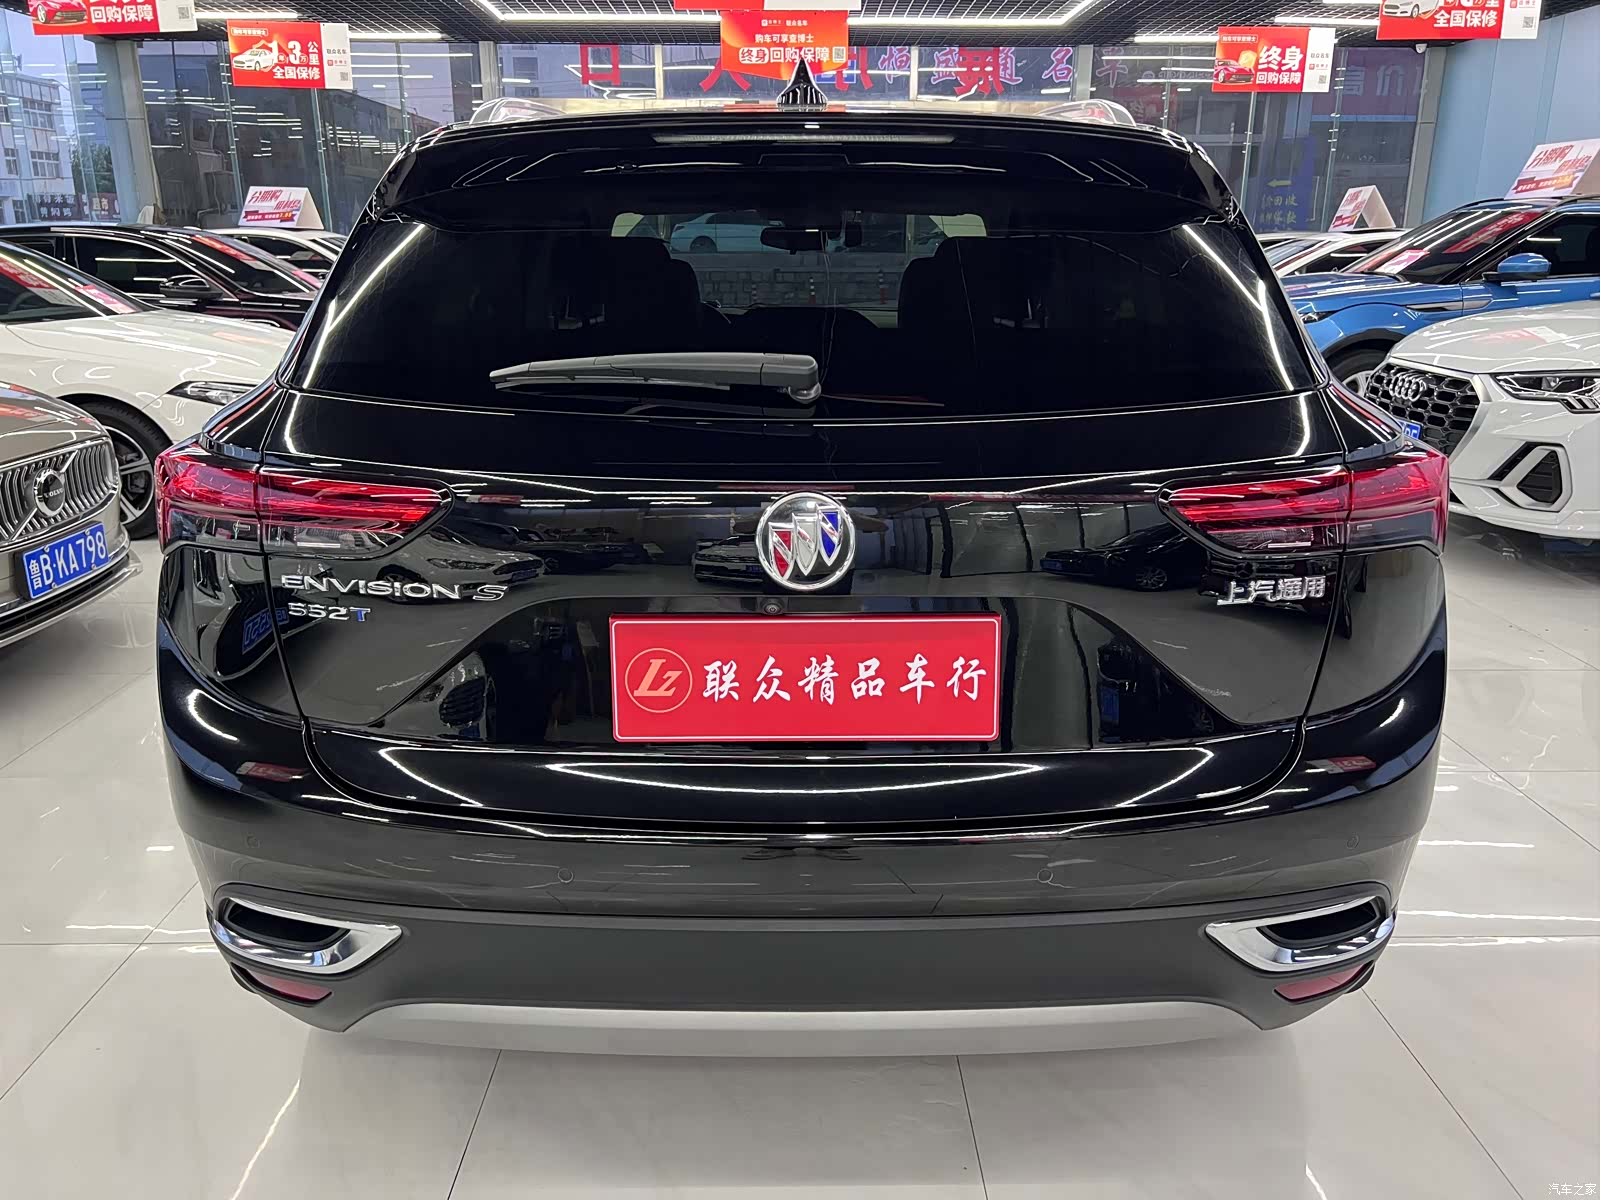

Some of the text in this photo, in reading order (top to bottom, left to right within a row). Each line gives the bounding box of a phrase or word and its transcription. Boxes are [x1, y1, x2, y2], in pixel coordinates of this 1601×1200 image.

[90, 5, 154, 23] 回购保障
[1433, 10, 1497, 28] 全国保修
[755, 33, 815, 43] 购车可享查博士
[740, 46, 830, 63] 终身回购保障
[1257, 45, 1304, 71] 终身
[272, 66, 320, 80] 全国保修
[1256, 71, 1302, 85] 回购保障
[281, 574, 509, 601] ENVISION S
[1216, 575, 1327, 606] 上汽通用
[287, 602, 371, 622] 552T
[702, 653, 987, 705] 联众精品车行
